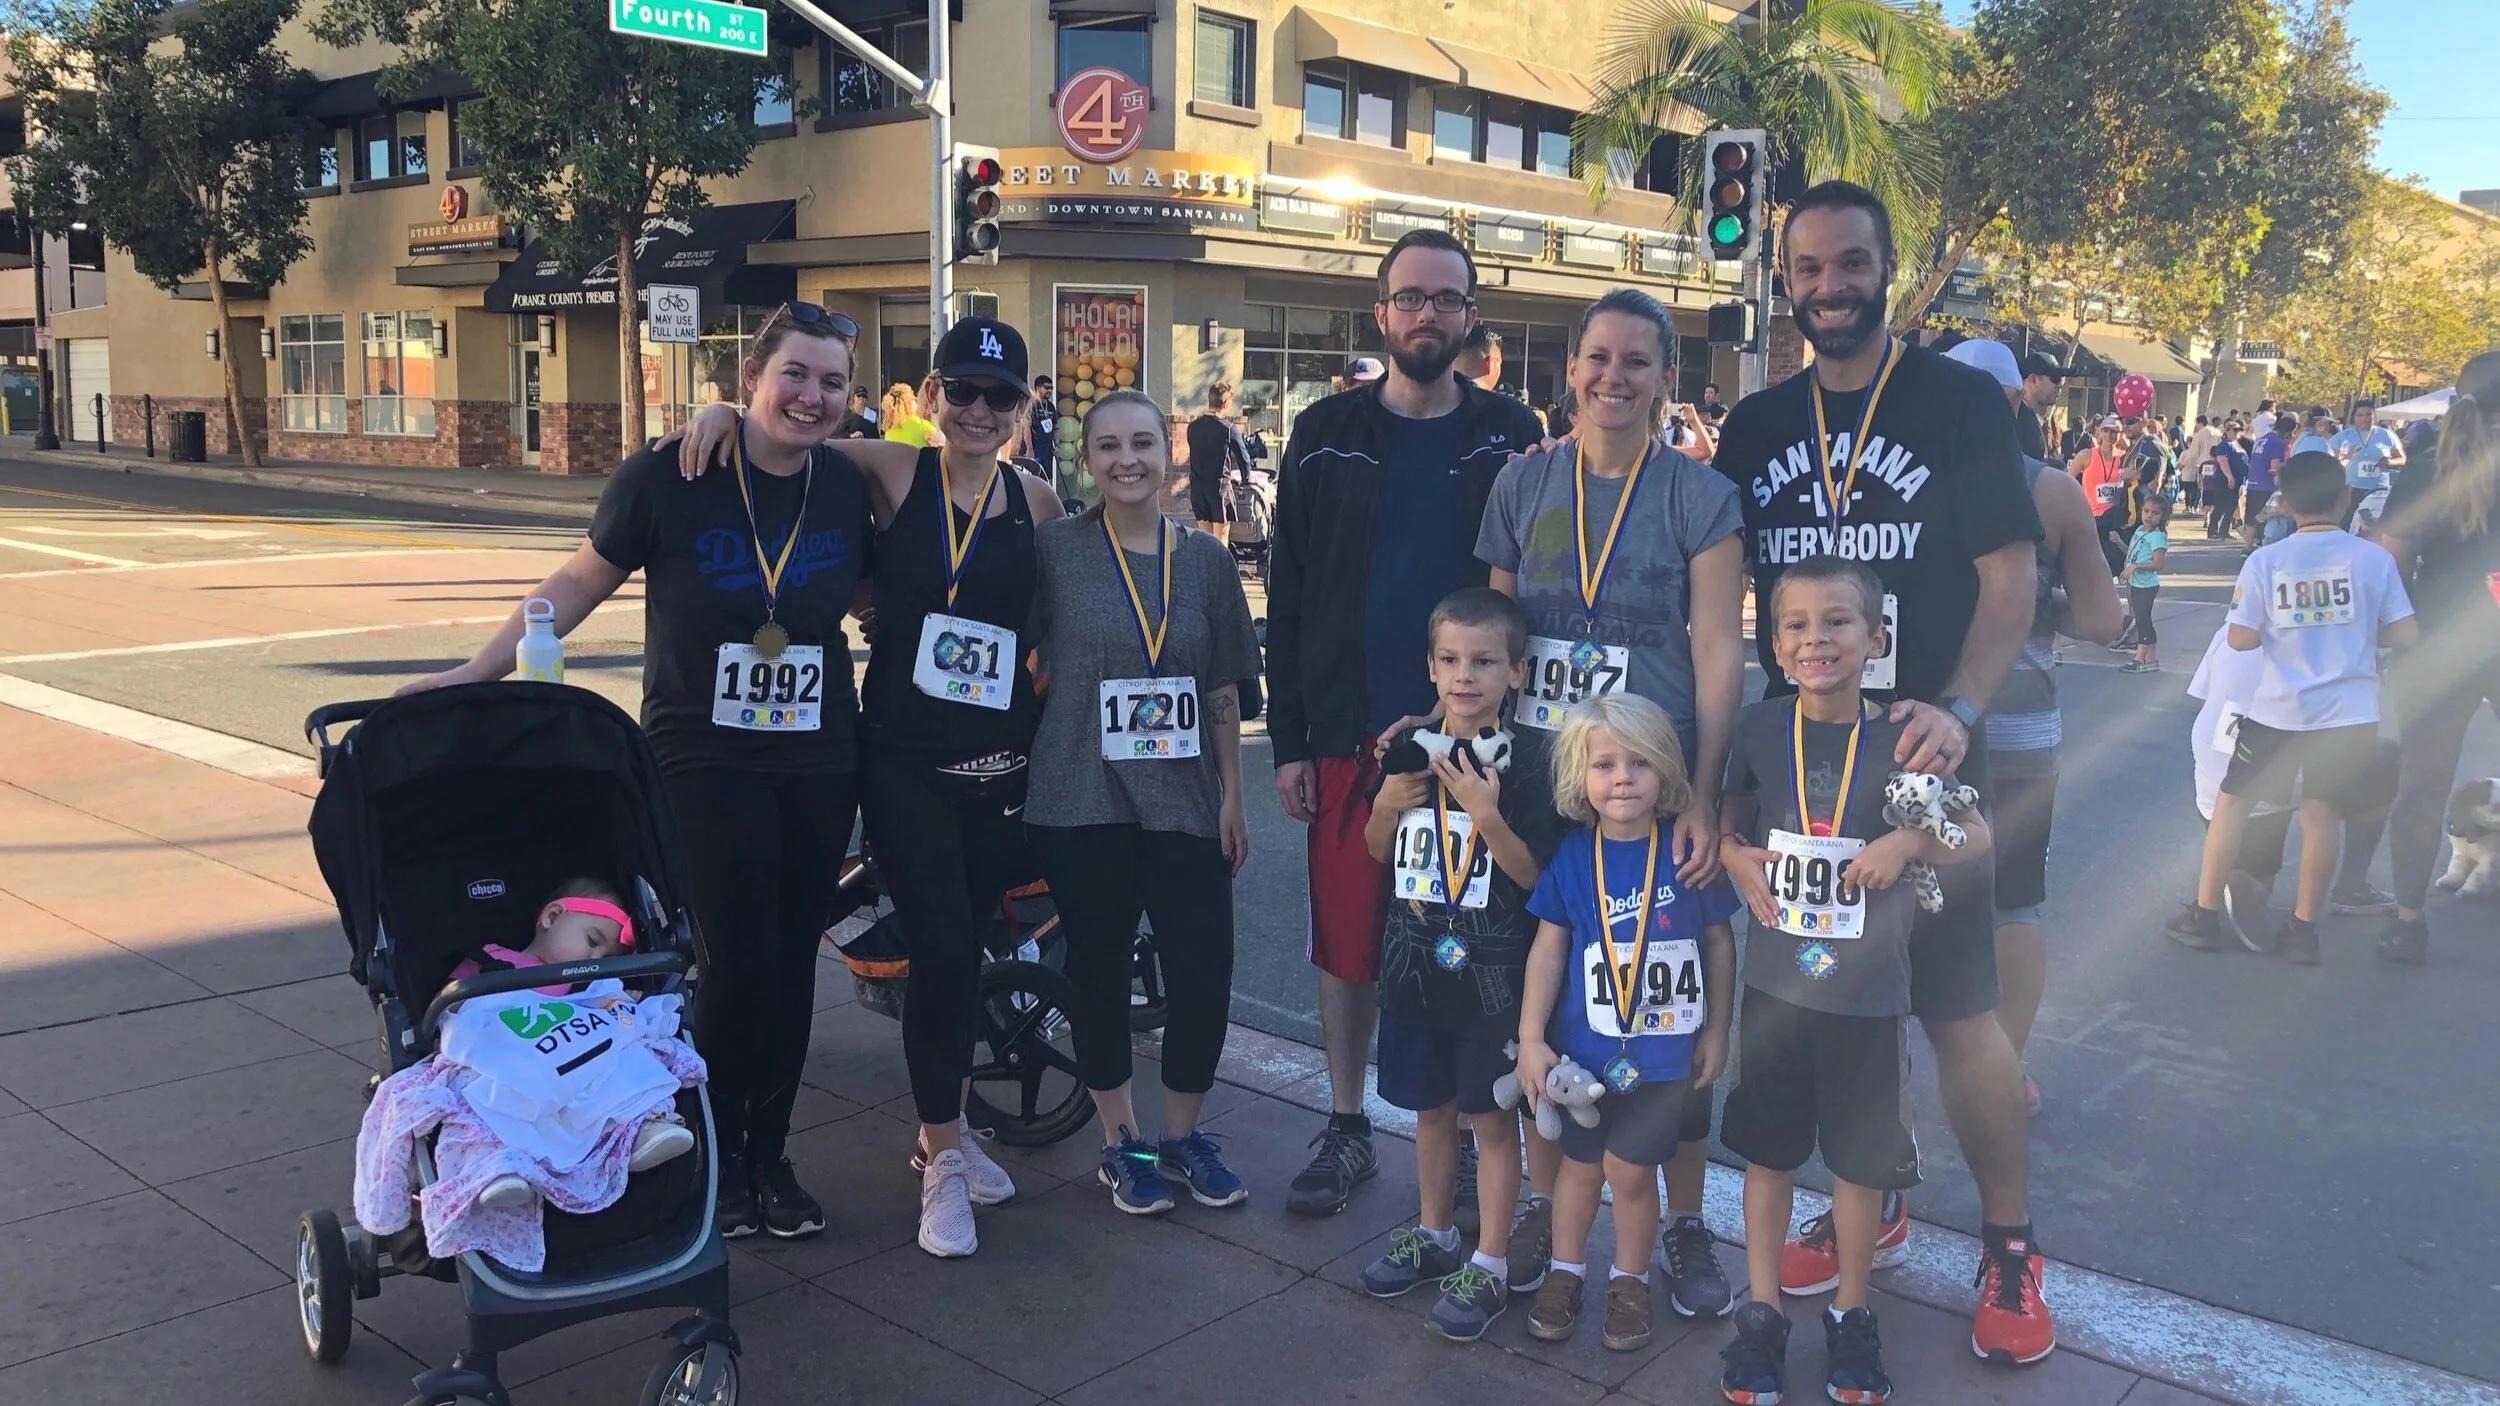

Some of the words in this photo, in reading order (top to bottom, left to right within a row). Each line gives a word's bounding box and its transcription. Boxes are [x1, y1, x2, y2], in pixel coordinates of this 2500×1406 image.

[622, 0, 711, 34] Fourth
[728, 13, 744, 27] ST
[719, 27, 745, 42] 200
[749, 32, 757, 44] E
[1106, 166, 1253, 195] MARKET
[1048, 204, 1153, 216] DOWNTOWN
[1161, 207, 1213, 220] SANTA
[1220, 212, 1245, 223] ANA
[410, 226, 448, 239] STREET
[452, 220, 496, 234] MARKET
[518, 294, 547, 306] ORANGE
[586, 291, 615, 304] PREMIER
[652, 326, 671, 337] FULL
[675, 327, 696, 339] LANE
[655, 315, 674, 326] MAY
[676, 315, 693, 326] USE
[979, 328, 1004, 360] LA
[1063, 331, 1137, 358] HELLO!
[1855, 435, 1932, 503] ANA
[1757, 522, 1923, 564] EVERYBODY
[2276, 578, 2351, 609] 1805
[721, 661, 821, 703] 1992
[1523, 655, 1623, 704] 1997
[1106, 692, 1195, 733] 1720
[1798, 838, 1825, 847] SANTA
[1826, 840, 1844, 848] ANA
[471, 884, 502, 896] chicco
[1769, 854, 1861, 906] 1998
[1663, 944, 1679, 952] ANA
[562, 964, 600, 976] BRAVO
[534, 1012, 610, 1055] DTSA
